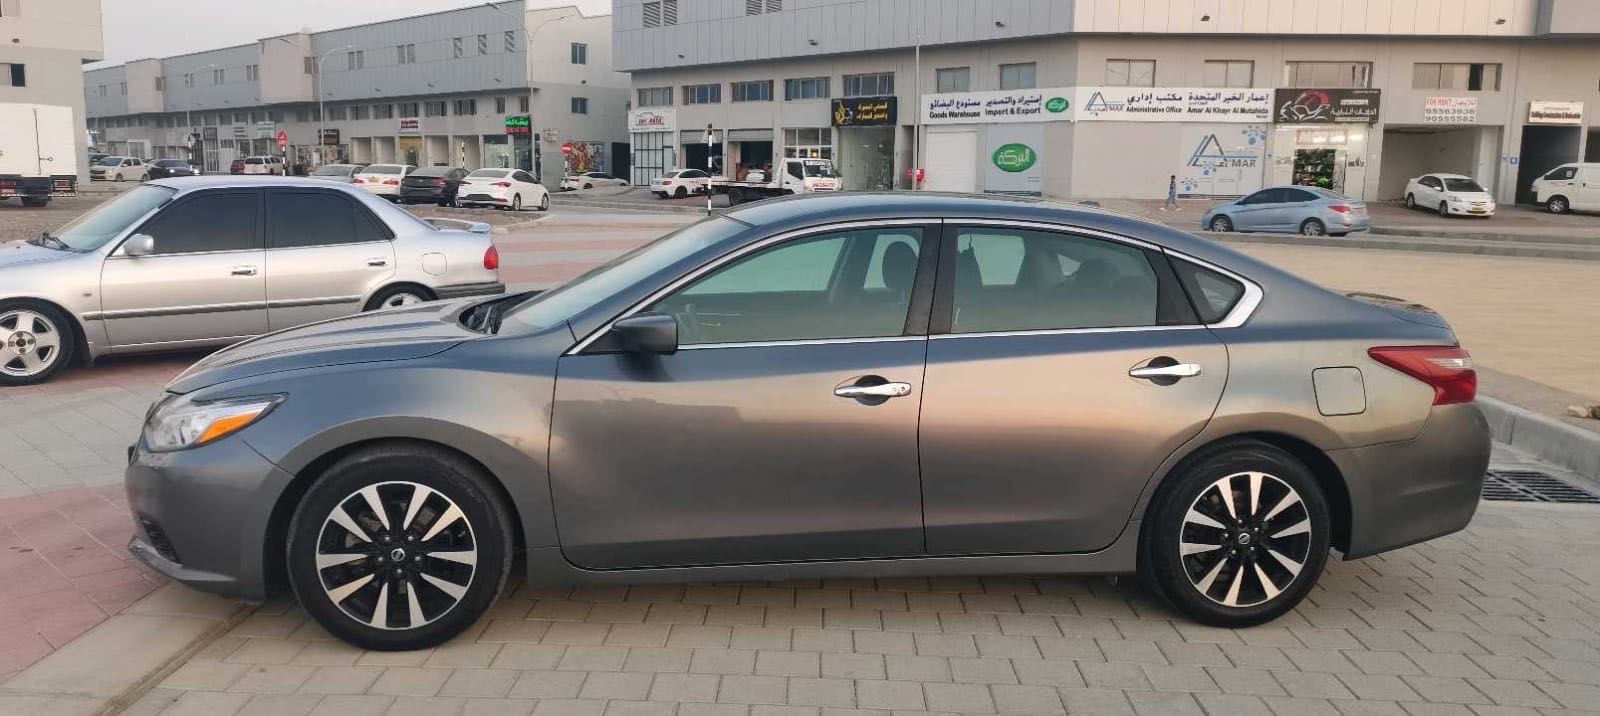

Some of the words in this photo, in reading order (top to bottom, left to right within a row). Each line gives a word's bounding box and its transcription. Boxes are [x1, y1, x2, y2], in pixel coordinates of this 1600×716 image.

[1156, 92, 1183, 102] مكتب
[985, 108, 1009, 117] Import
[1017, 106, 1041, 116] Export
[1126, 105, 1165, 113] Administrative
[1165, 105, 1182, 114] Office
[929, 111, 948, 119] Goods
